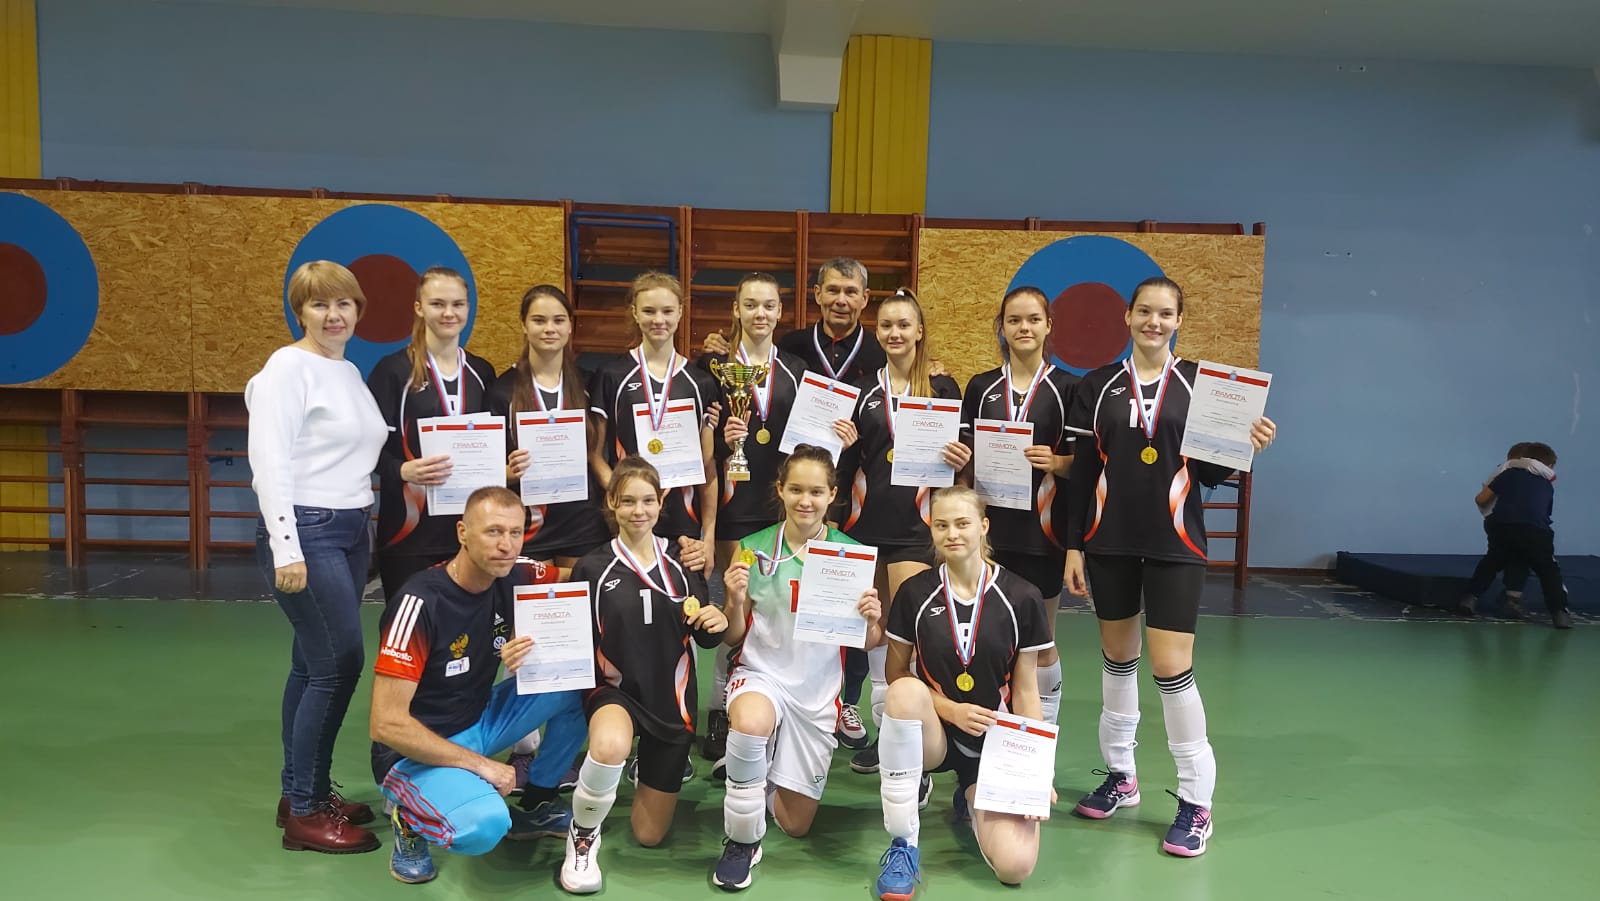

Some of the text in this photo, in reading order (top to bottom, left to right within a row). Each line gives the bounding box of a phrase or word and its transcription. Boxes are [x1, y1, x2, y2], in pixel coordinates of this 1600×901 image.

[1210, 388, 1247, 403] ГРАМОТА
[912, 420, 944, 429] ГРАМОТА
[536, 434, 569, 443] ГРАМОТА
[452, 441, 489, 449] ГРАМОТА
[988, 442, 1018, 451] ГРАМОТА
[820, 567, 857, 578] ГРАМОТА
[640, 589, 653, 624] 1
[533, 611, 572, 621] ГРАМОТА
[1002, 739, 1038, 754] ГРАМОТА
